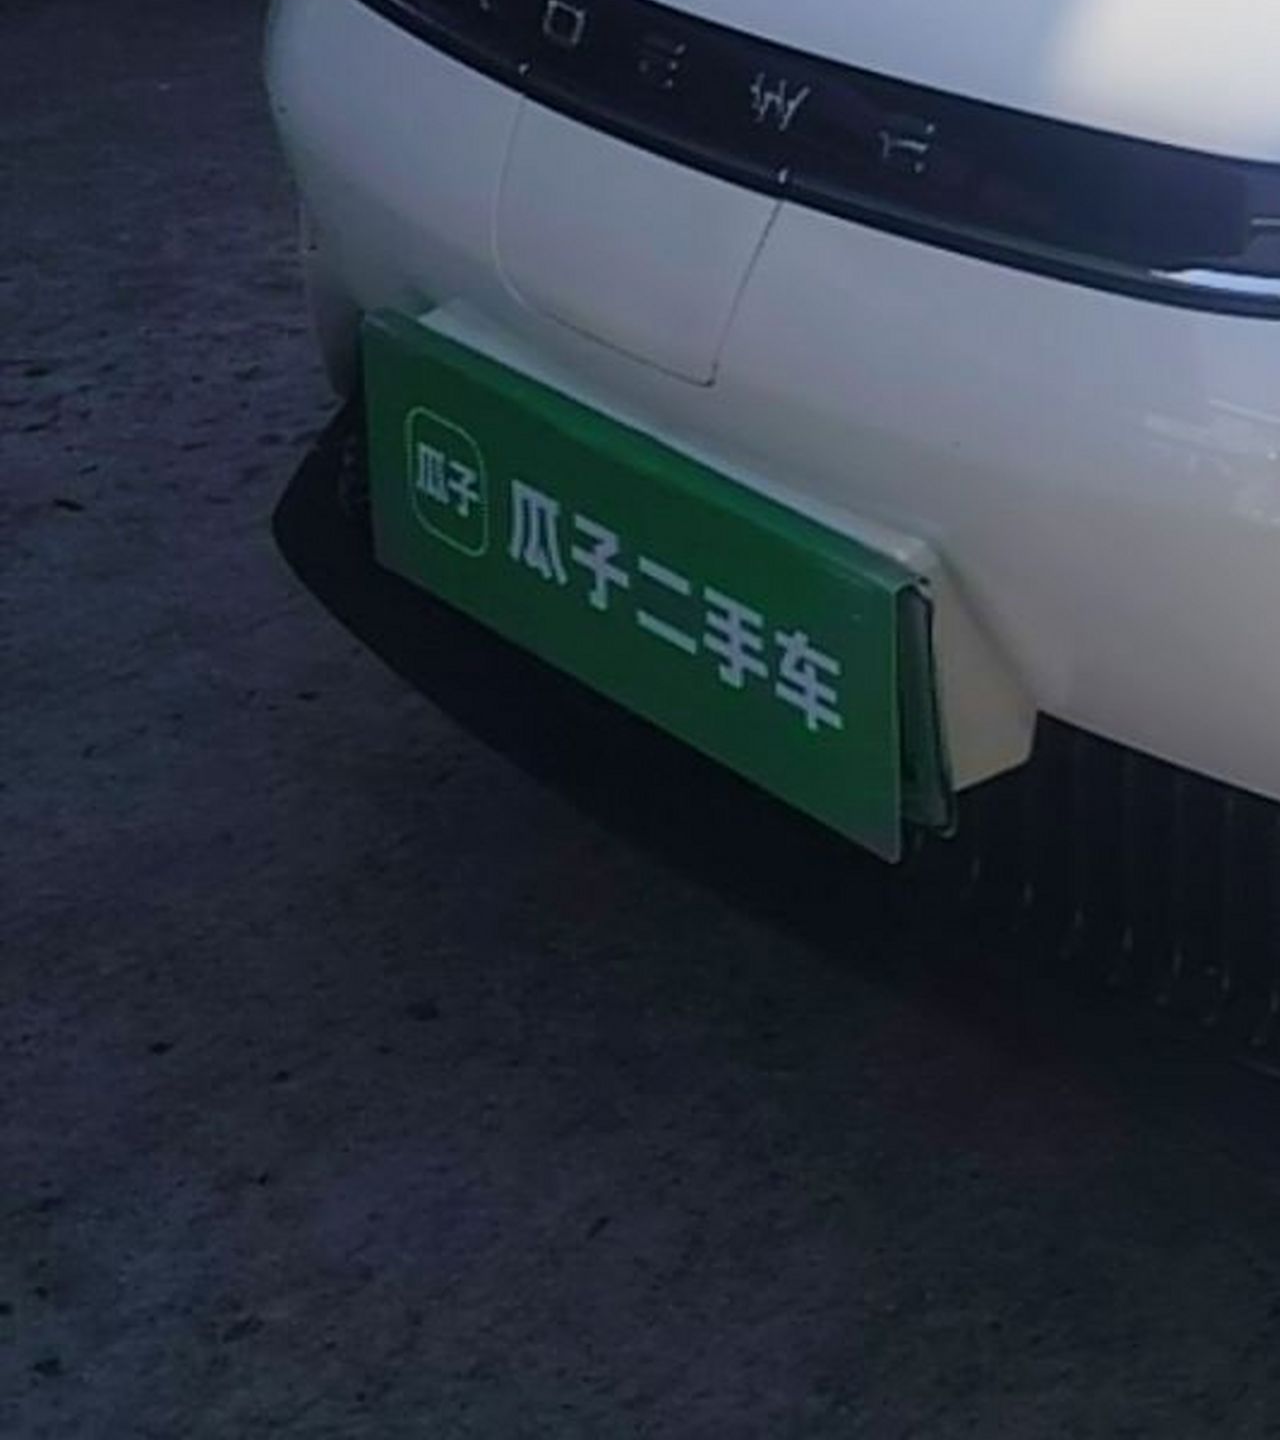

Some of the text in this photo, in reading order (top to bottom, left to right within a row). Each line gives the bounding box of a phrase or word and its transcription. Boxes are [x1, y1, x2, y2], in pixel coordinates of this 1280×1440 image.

[416, 442, 480, 516] 瓜子
[509, 478, 842, 733] 瓜子二手车
